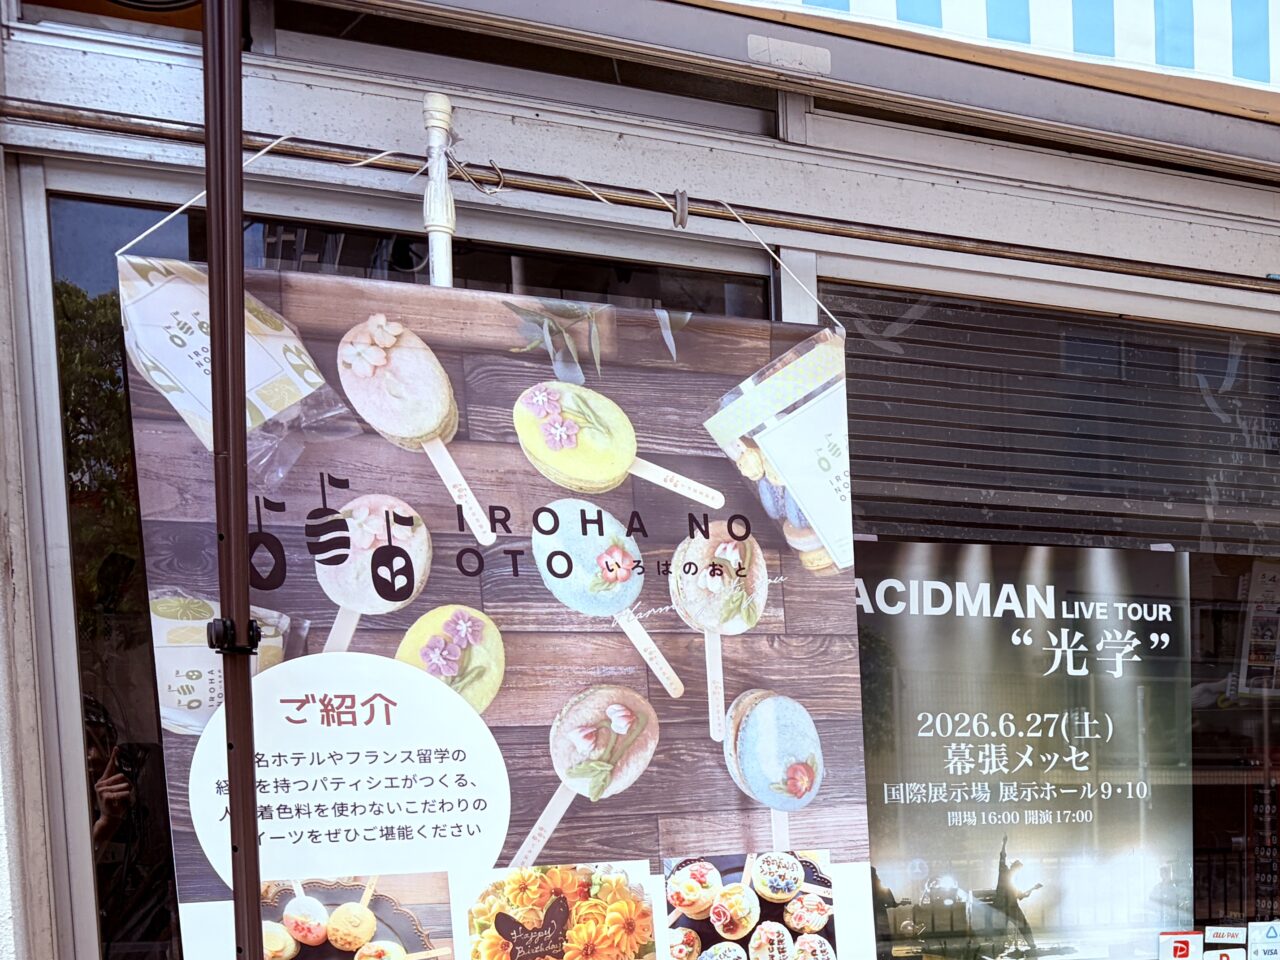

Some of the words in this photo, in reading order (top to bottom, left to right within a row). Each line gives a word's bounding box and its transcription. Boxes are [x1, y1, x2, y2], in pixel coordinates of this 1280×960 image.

[456, 504, 648, 538] IROHA
[688, 512, 751, 542] NO
[456, 548, 573, 579] OTO
[605, 559, 748, 578] いろはのおと
[854, 579, 1056, 619] ACIDMAN
[1062, 601, 1108, 620] LIVE
[1114, 602, 1173, 622] TOUR
[279, 692, 398, 727] ご紹介
[916, 711, 1114, 743] 2026.6.27(土)
[253, 746, 467, 768] 名ホテルやフランス留学の
[943, 743, 1091, 776] 幕張メッセ
[215, 771, 478, 796] 経を持つパティシエがつくる、
[883, 782, 992, 805] 国際展示場
[999, 781, 1148, 802] 展示ホール9・10
[219, 797, 488, 822] 人着色料を使わないこだわりの
[947, 811, 977, 827] 開場
[981, 811, 1020, 825] 16:00
[1025, 810, 1053, 825] 開演
[1056, 810, 1093, 824] 17:00
[257, 824, 482, 846] イーツをぜひご堪能ください
